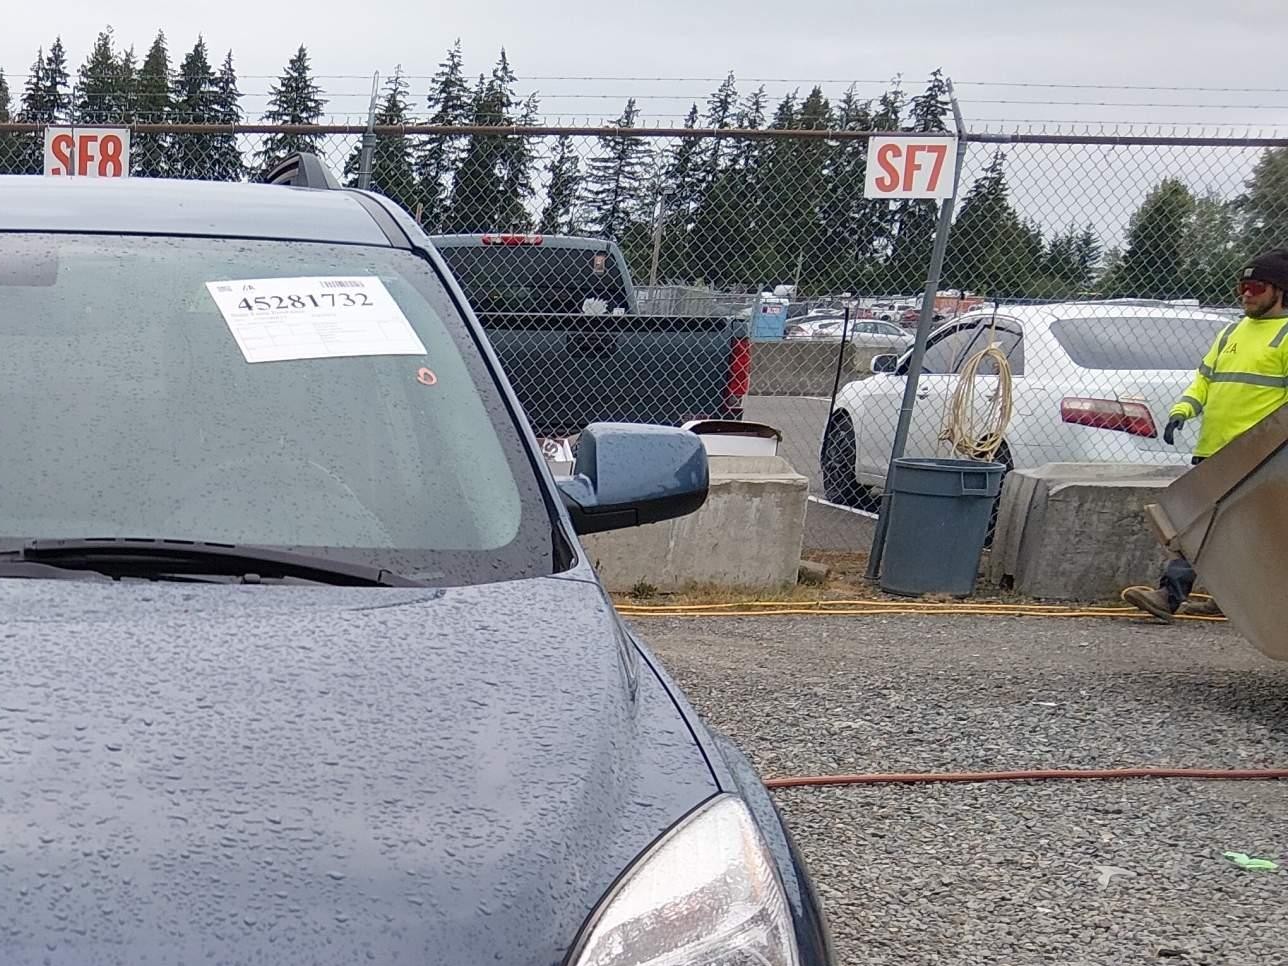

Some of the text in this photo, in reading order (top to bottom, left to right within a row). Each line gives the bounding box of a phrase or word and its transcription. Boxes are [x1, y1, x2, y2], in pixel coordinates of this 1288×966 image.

[51, 134, 123, 177] SF8
[874, 143, 948, 193] SF7
[238, 293, 374, 311] 45281732
